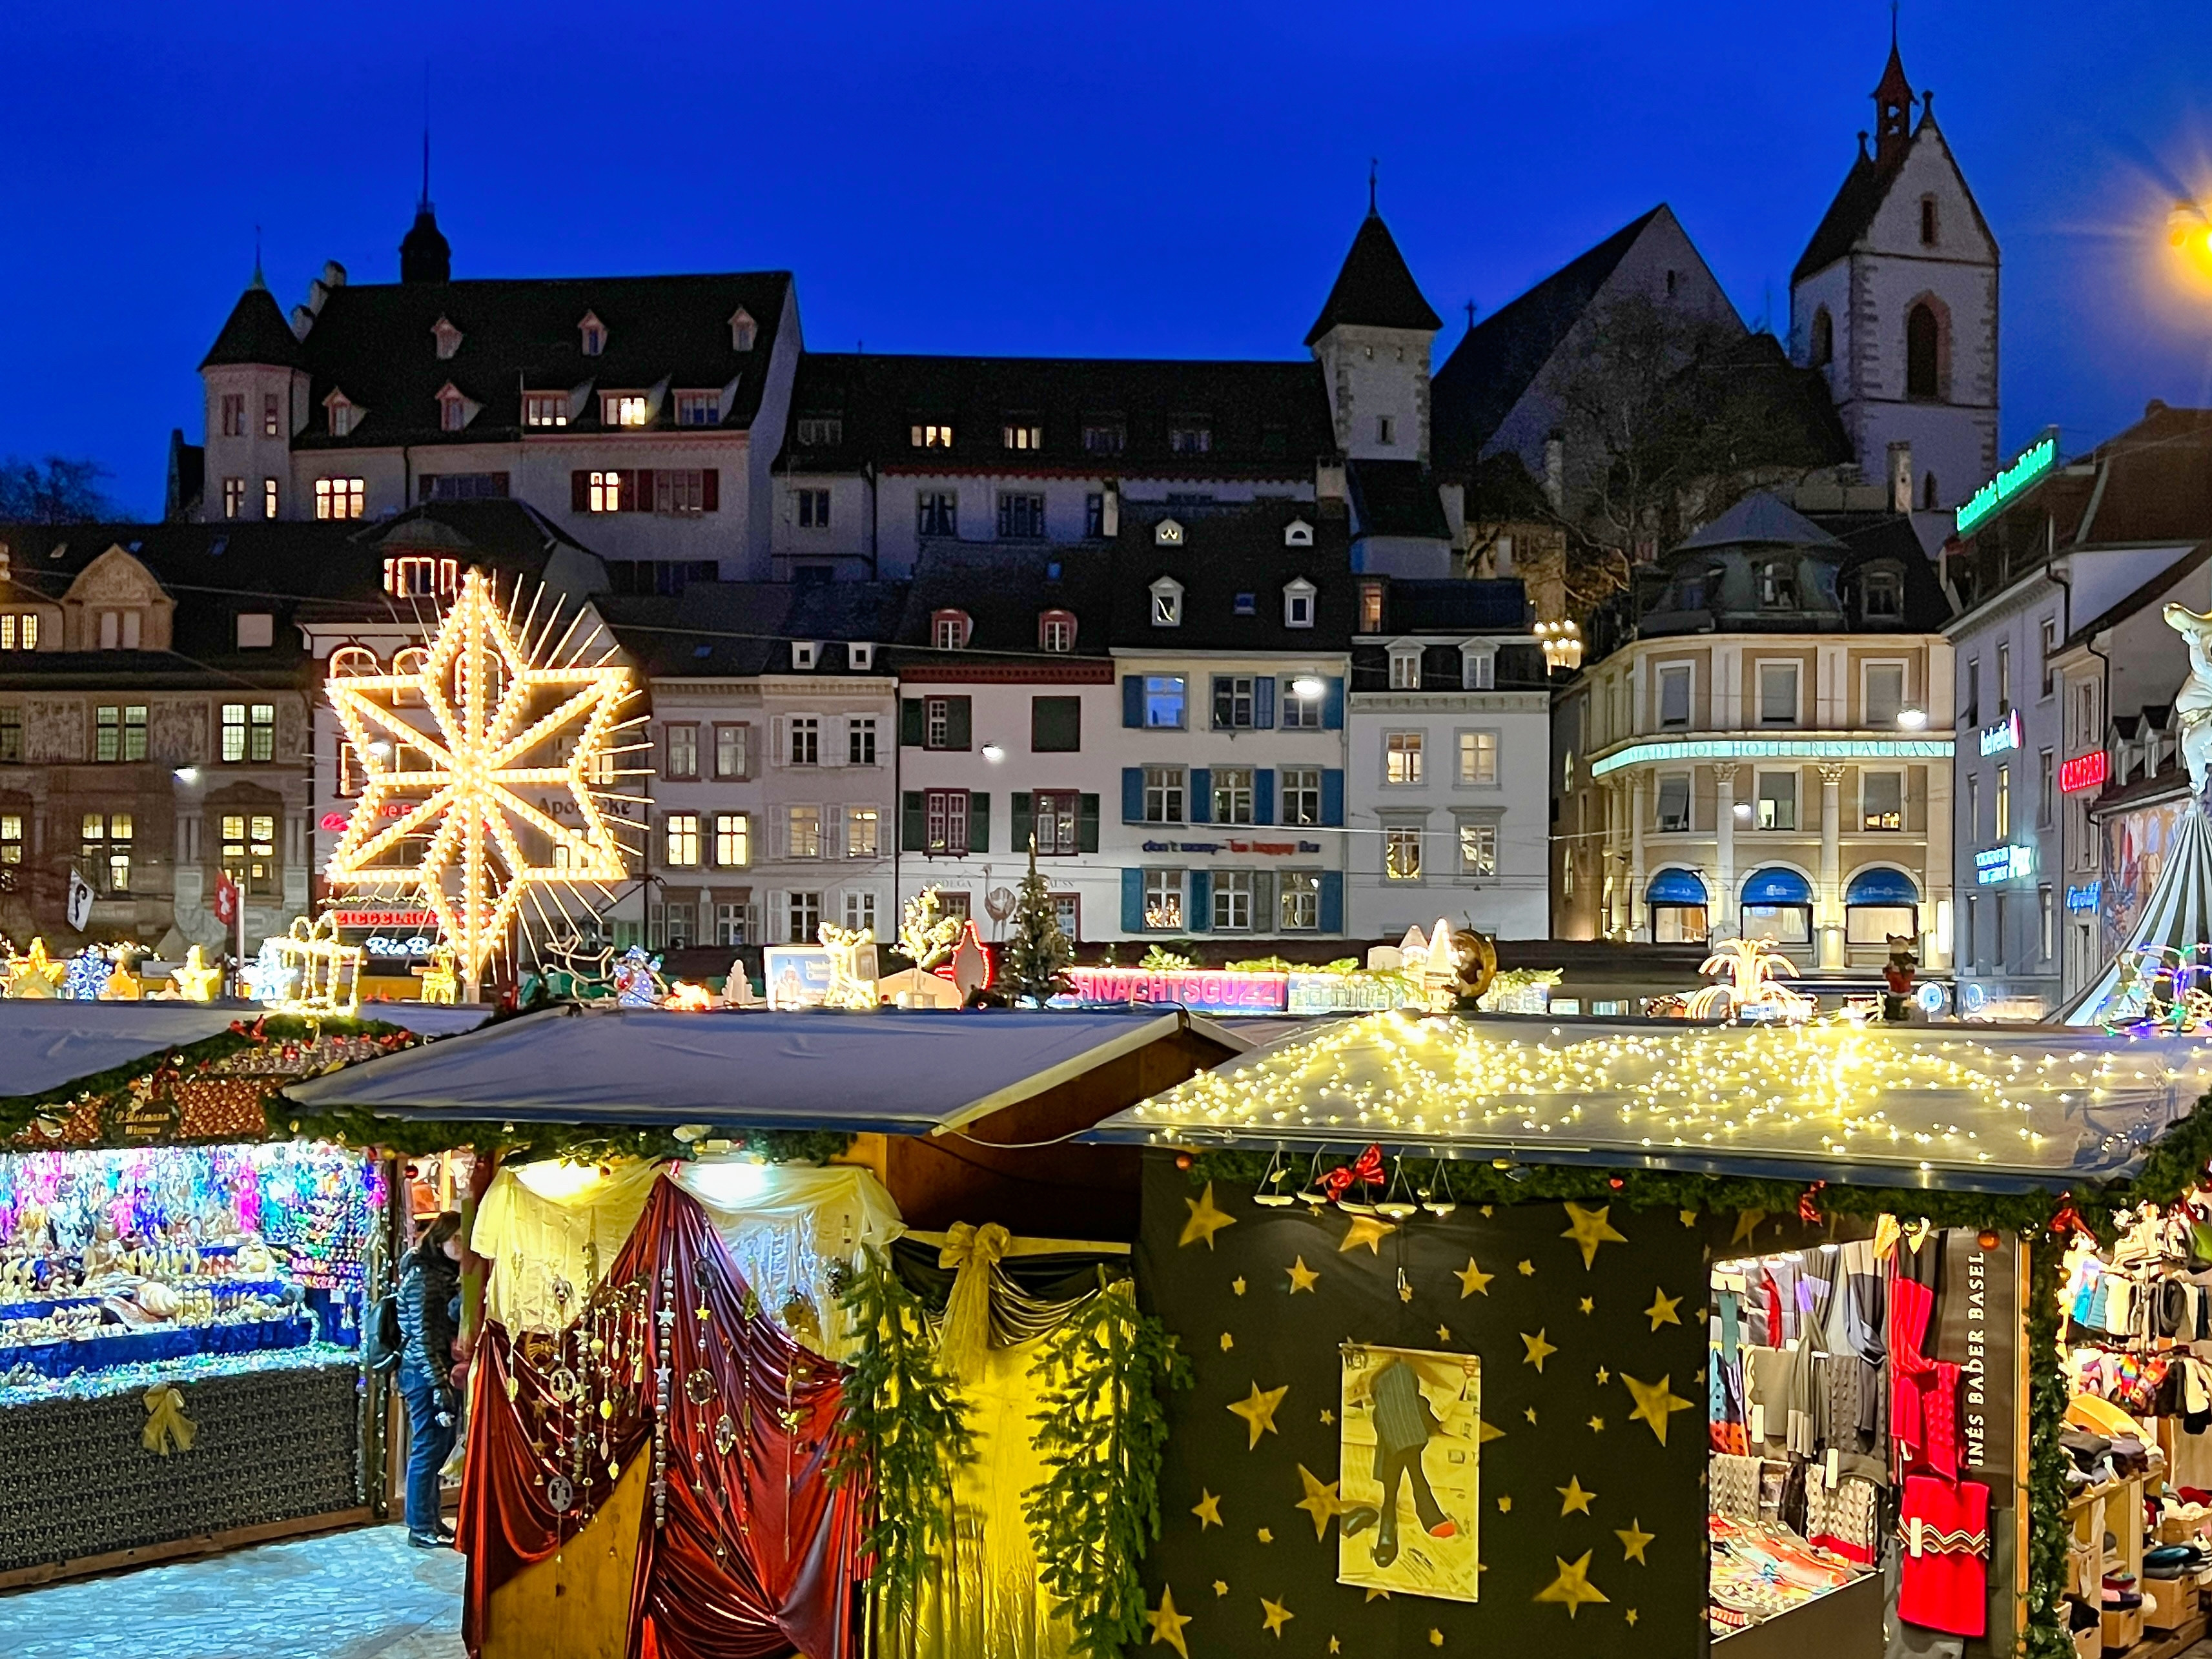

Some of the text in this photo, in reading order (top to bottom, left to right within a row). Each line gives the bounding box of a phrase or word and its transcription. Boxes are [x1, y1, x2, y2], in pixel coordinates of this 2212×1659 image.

[1074, 973, 1284, 1006] HNACHTSGUZZI
[1967, 1251, 1985, 1321] BASEL
[1967, 1329, 1985, 1405] BADER
